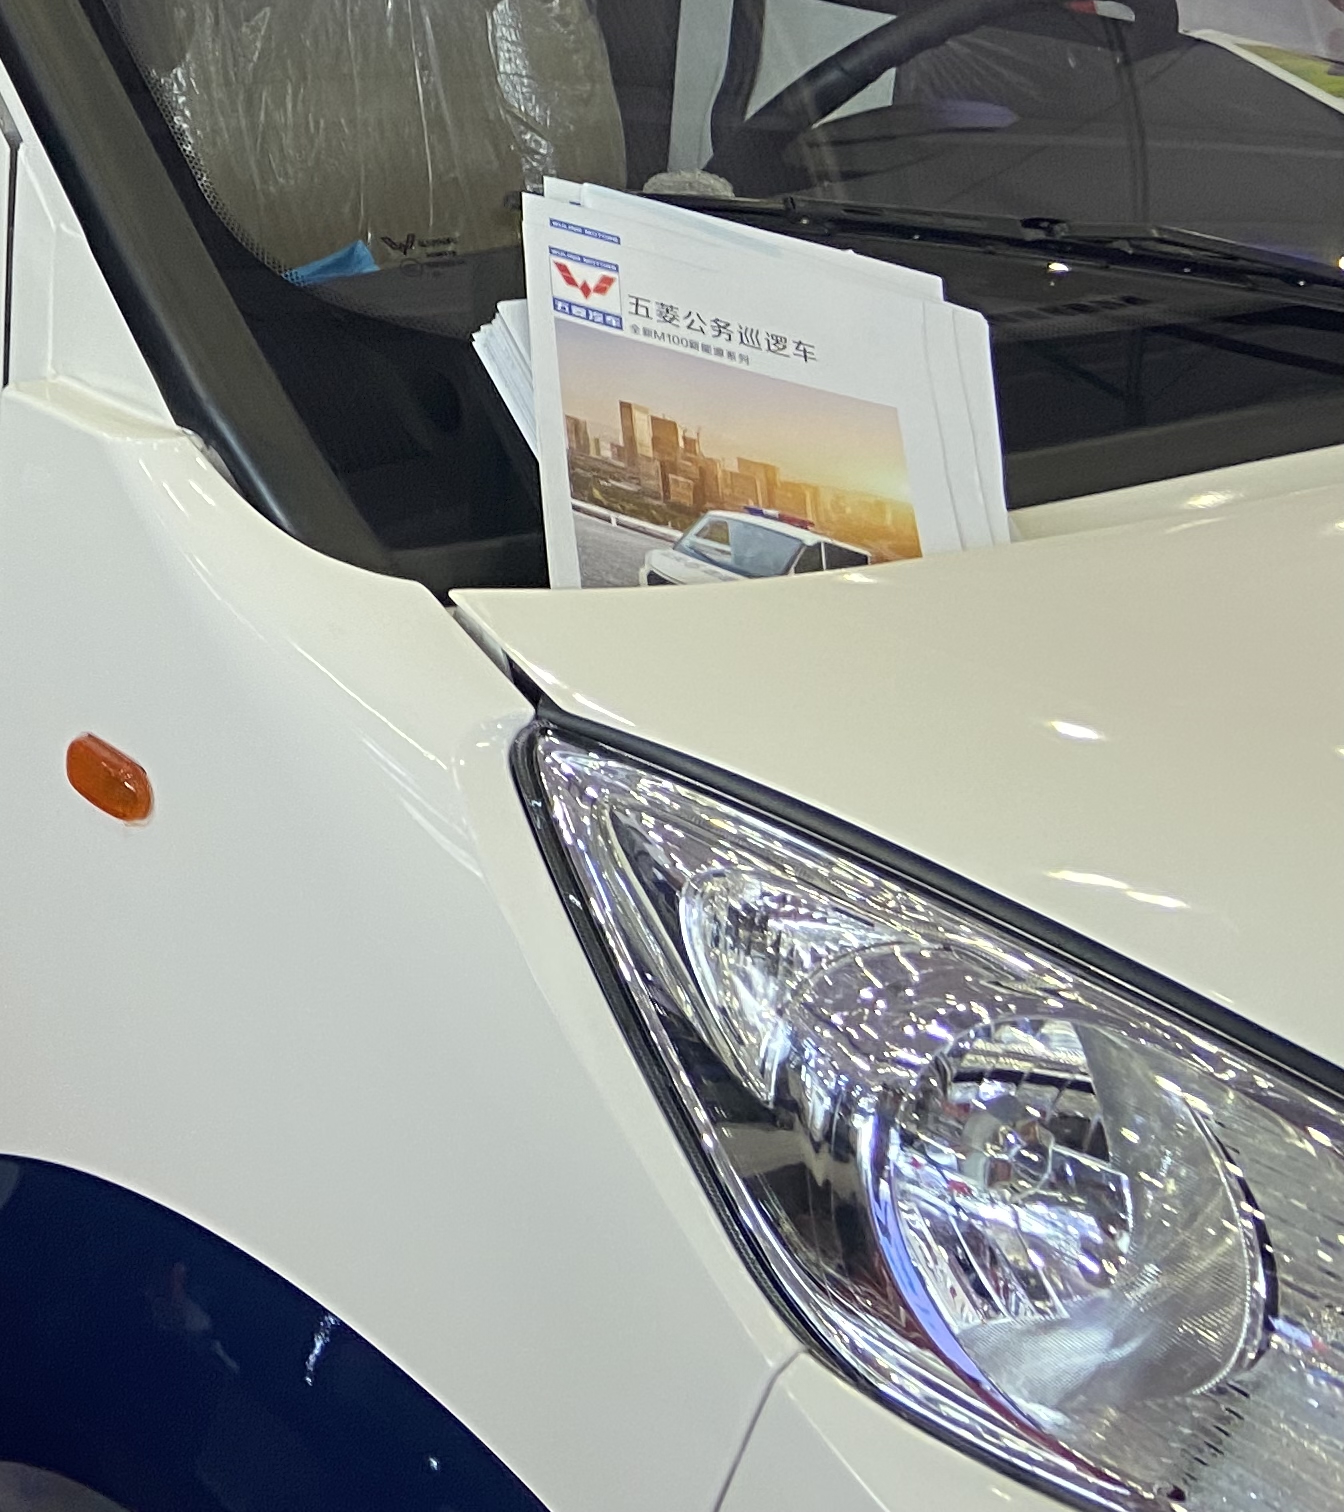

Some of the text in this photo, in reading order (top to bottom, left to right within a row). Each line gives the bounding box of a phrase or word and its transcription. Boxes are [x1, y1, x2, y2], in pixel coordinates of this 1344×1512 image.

[627, 293, 818, 364] 五菱公务巡逻车
